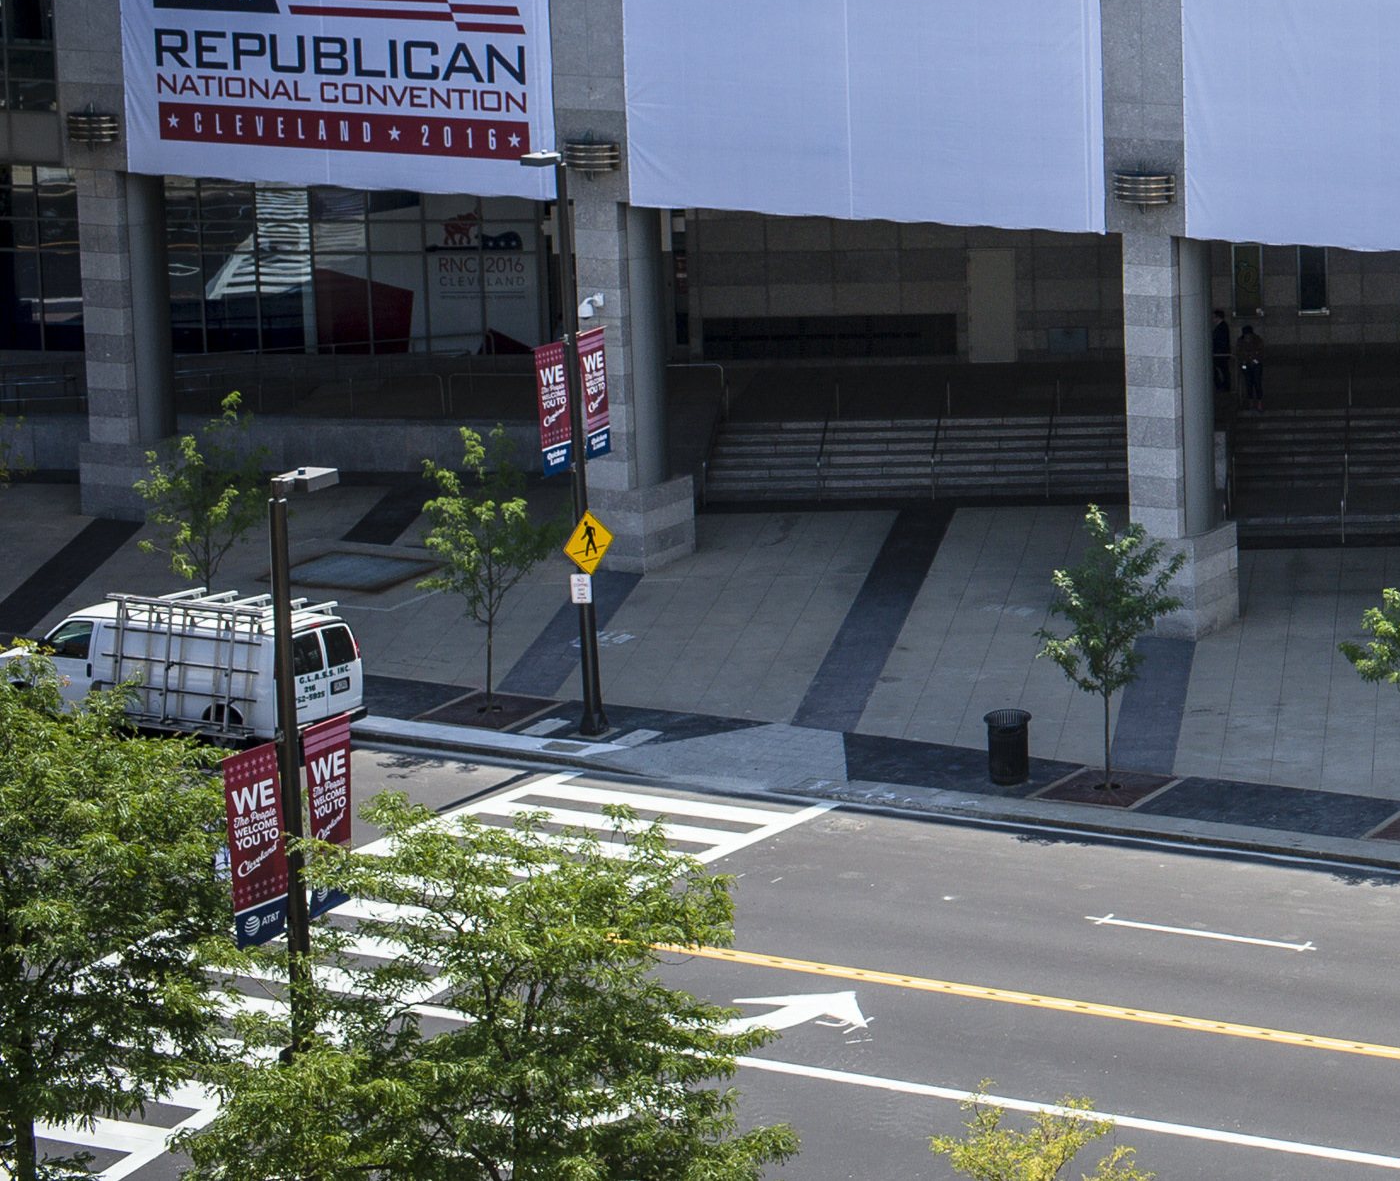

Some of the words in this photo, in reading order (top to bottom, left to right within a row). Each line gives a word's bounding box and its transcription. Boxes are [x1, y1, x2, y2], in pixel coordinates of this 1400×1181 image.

[154, 27, 527, 86] REPUBLICAN
[156, 72, 311, 102] NATIONAL
[320, 81, 527, 114] CONVENTION
[193, 111, 372, 143] CLEVELAND
[421, 124, 498, 151] 2016
[438, 257, 477, 273] RNC
[486, 257, 525, 273] 2016
[583, 350, 604, 372] WE
[540, 364, 565, 386] WE
[587, 386, 598, 396] YOU
[598, 382, 606, 390] TO
[542, 399, 556, 409] YOU
[557, 396, 567, 406] TO
[310, 748, 346, 785] WE
[231, 778, 276, 815] WE
[313, 786, 324, 798] The
[324, 776, 346, 792] People
[313, 786, 347, 808] WELCOME
[233, 816, 250, 829] The
[250, 807, 276, 823] People
[314, 802, 332, 820] YOU
[333, 795, 347, 810] TO
[234, 816, 279, 839] WELCOME
[235, 833, 261, 851] YOU
[262, 827, 280, 842] TO
[237, 838, 280, 878] Cleveland
[261, 910, 281, 927] AT&T
